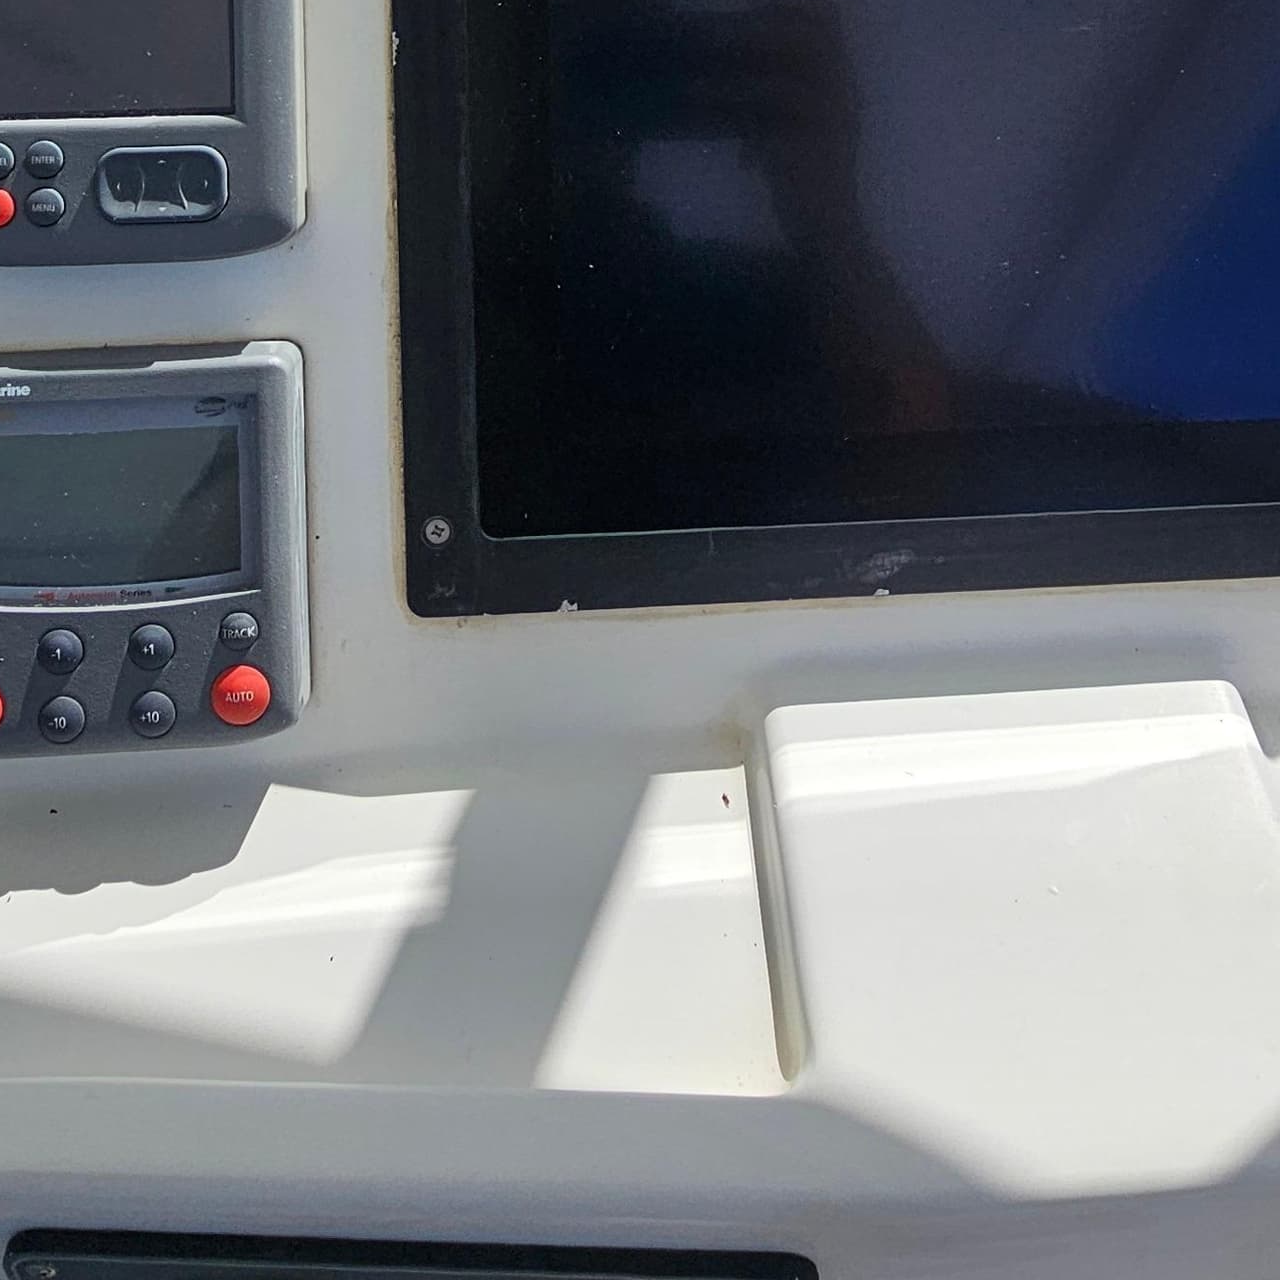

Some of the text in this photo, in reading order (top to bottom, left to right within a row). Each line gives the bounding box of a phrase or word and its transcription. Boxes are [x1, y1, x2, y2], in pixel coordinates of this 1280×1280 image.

[31, 155, 56, 165] ENTER
[31, 203, 56, 214] MENU
[221, 625, 256, 640] TRACK
[142, 643, 155, 656] +1
[225, 690, 255, 704] AUTO
[48, 716, 67, 730] -10
[140, 711, 161, 724] +10
